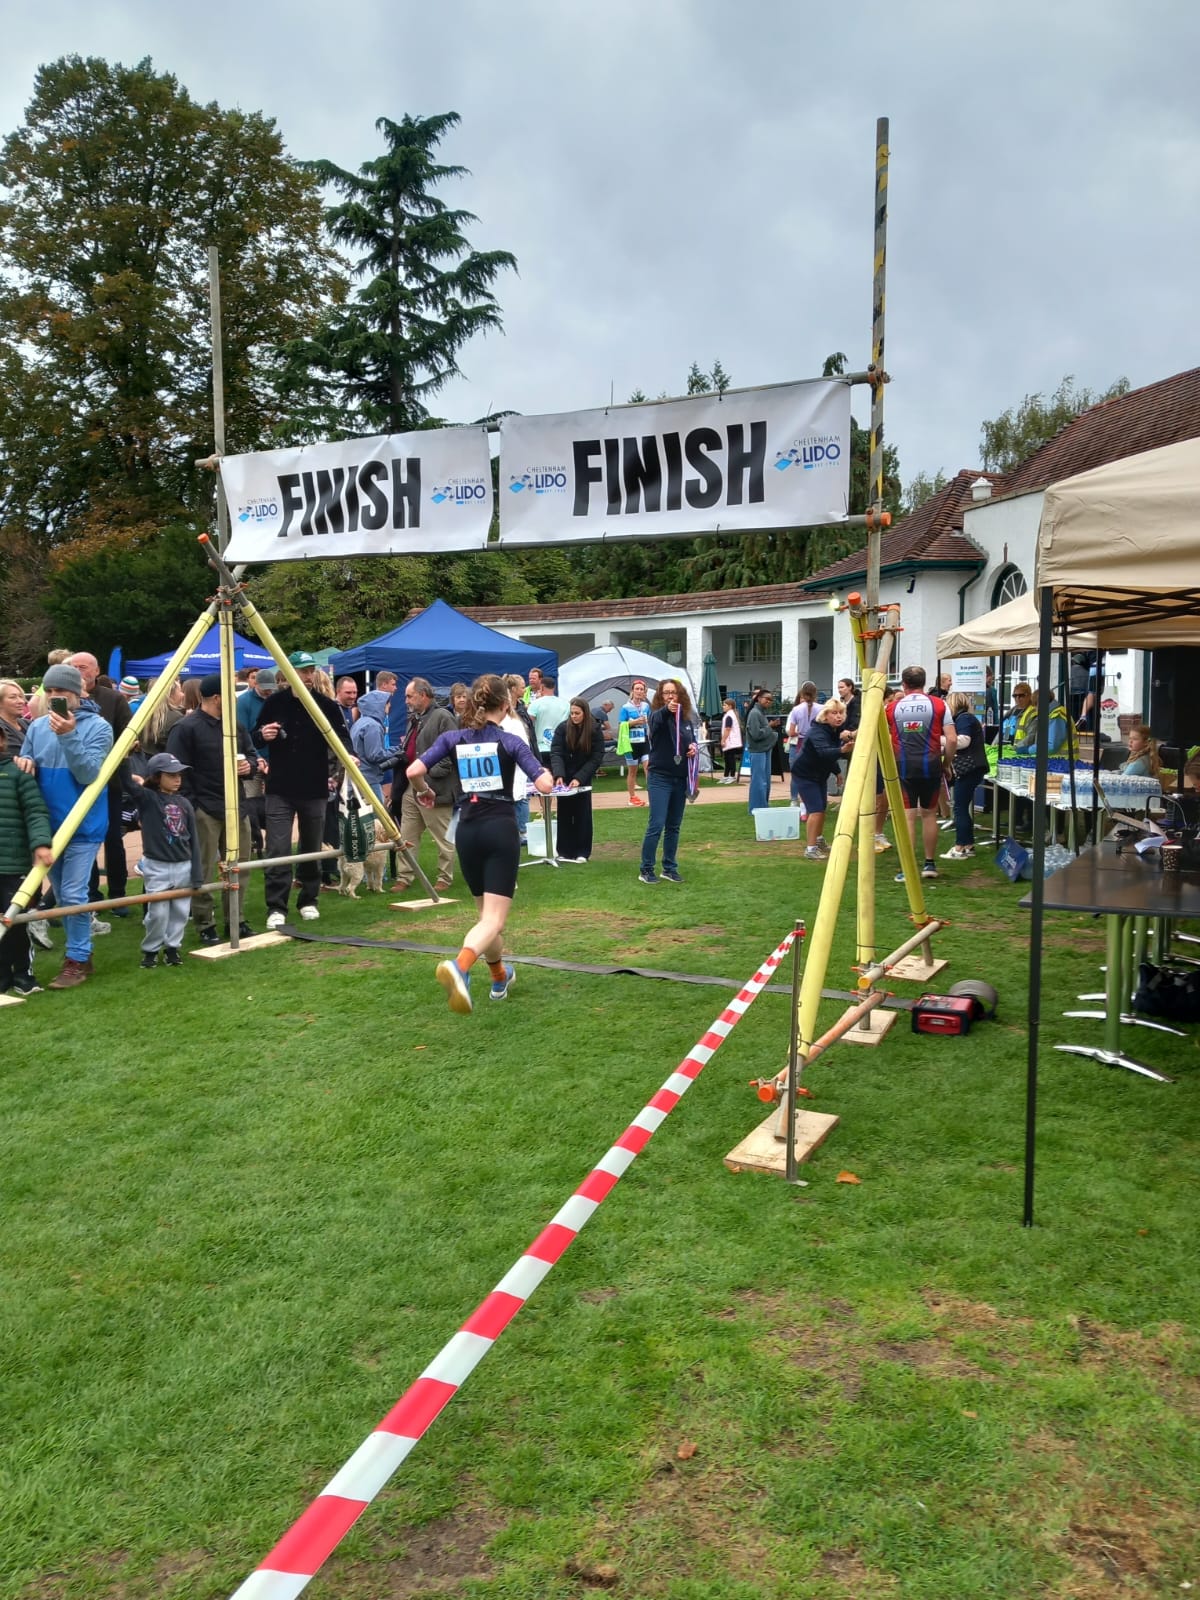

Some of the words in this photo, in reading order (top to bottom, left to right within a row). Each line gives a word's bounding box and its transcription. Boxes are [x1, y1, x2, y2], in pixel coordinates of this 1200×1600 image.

[794, 435, 841, 446] CHELTENHAM
[803, 443, 841, 463] LIDO
[526, 465, 566, 473] CHELTENHAM
[572, 421, 767, 516] FINISH
[535, 473, 567, 489] LIDO
[277, 457, 421, 538] FINISH
[455, 485, 486, 500] LIDO
[255, 503, 278, 517] LIDO
[900, 705, 927, 714] Y-TRI
[467, 757, 494, 778] 110
